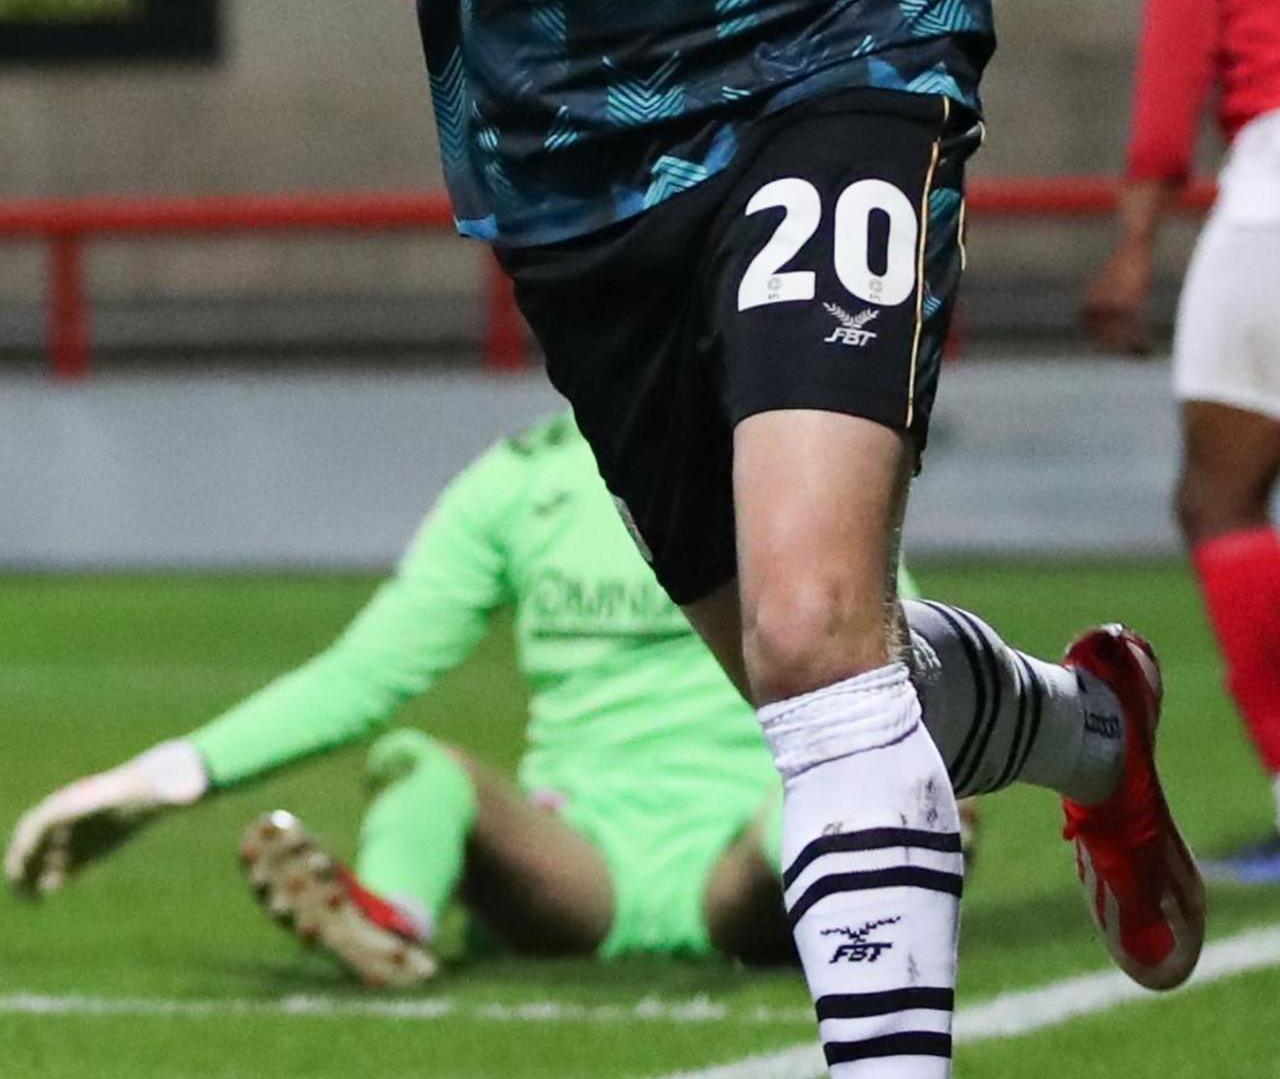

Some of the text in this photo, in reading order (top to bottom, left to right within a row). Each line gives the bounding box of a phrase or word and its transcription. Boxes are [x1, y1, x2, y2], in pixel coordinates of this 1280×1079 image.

[737, 177, 919, 312] 20
[823, 327, 877, 347] FBT
[829, 942, 892, 964] FBT
